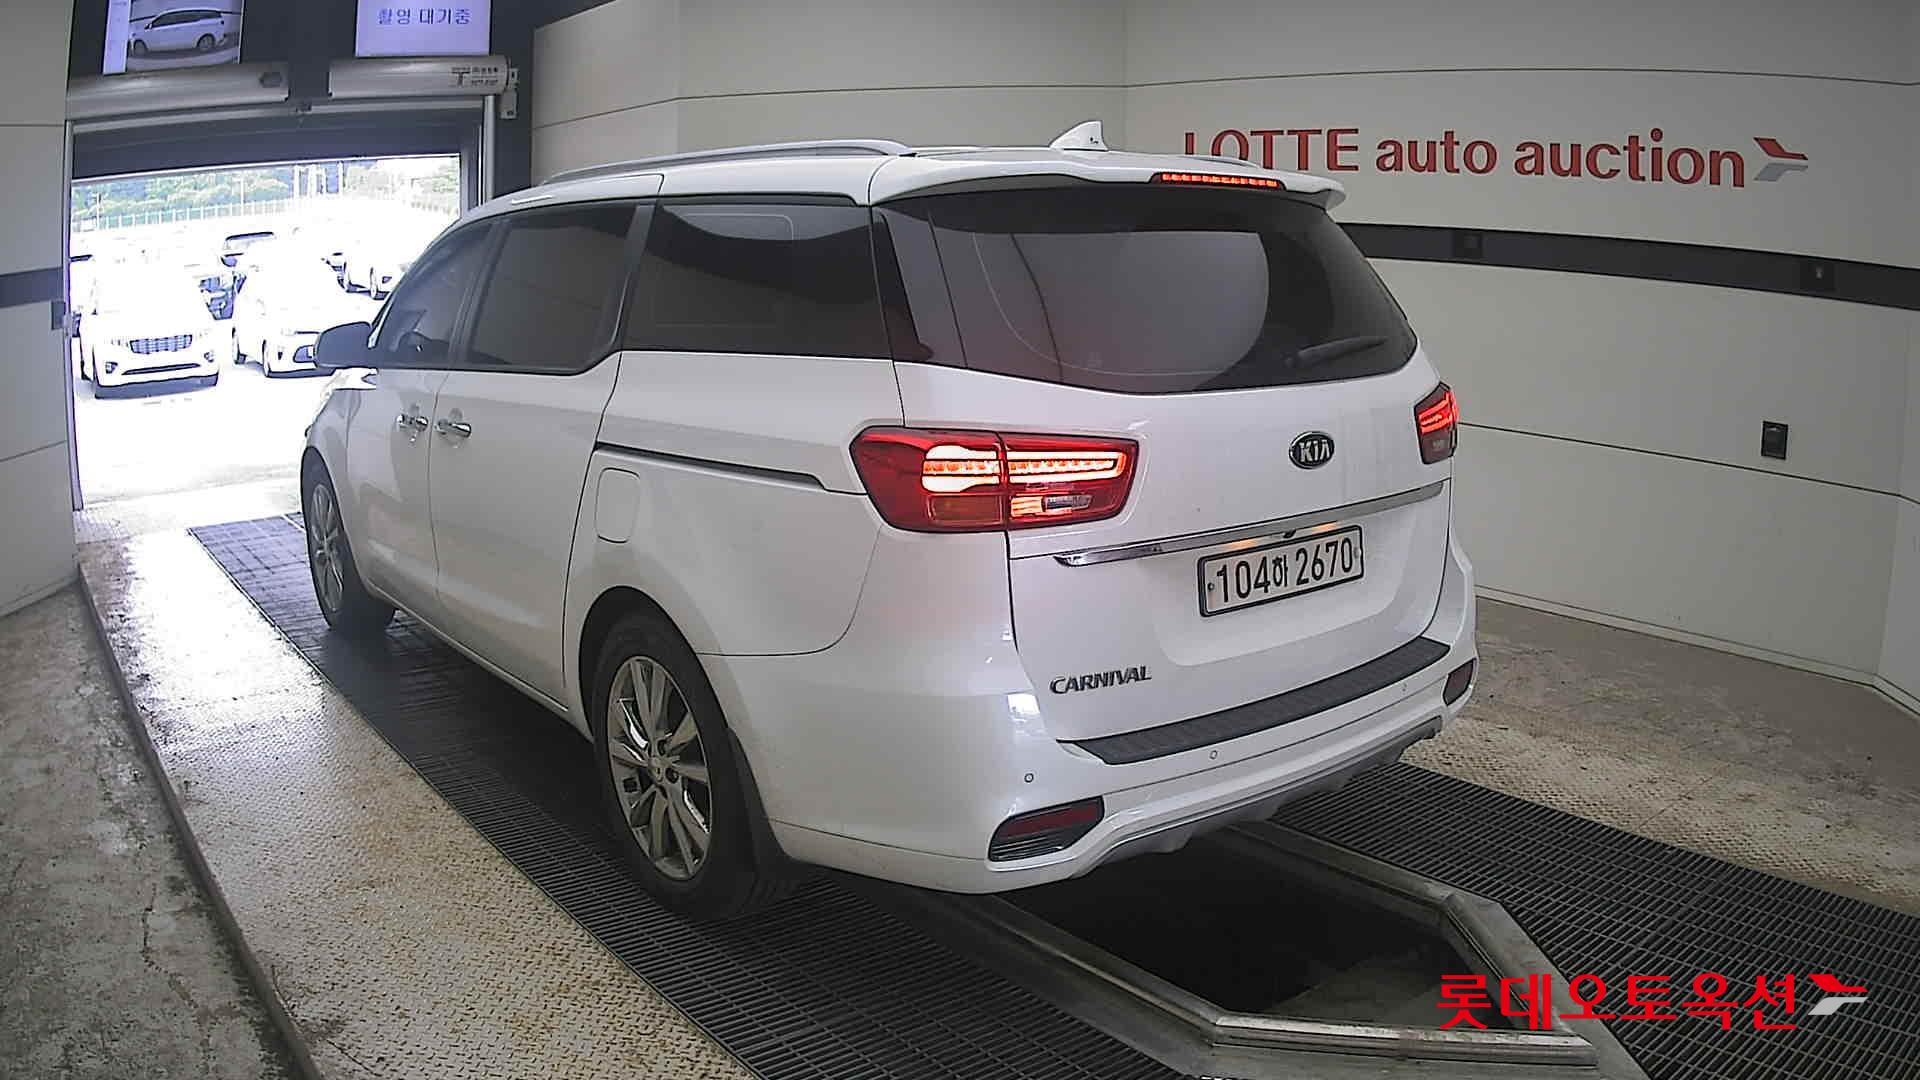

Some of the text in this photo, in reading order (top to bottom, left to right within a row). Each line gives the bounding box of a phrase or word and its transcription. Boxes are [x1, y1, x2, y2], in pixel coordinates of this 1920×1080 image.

[419, 8, 471, 25] 대기중
[1376, 130, 1497, 173] auto
[1514, 128, 1744, 188] auction
[1298, 439, 1331, 462] KIA
[1216, 537, 1353, 603] 104하 2670
[1049, 665, 1152, 694] CARNIVAL
